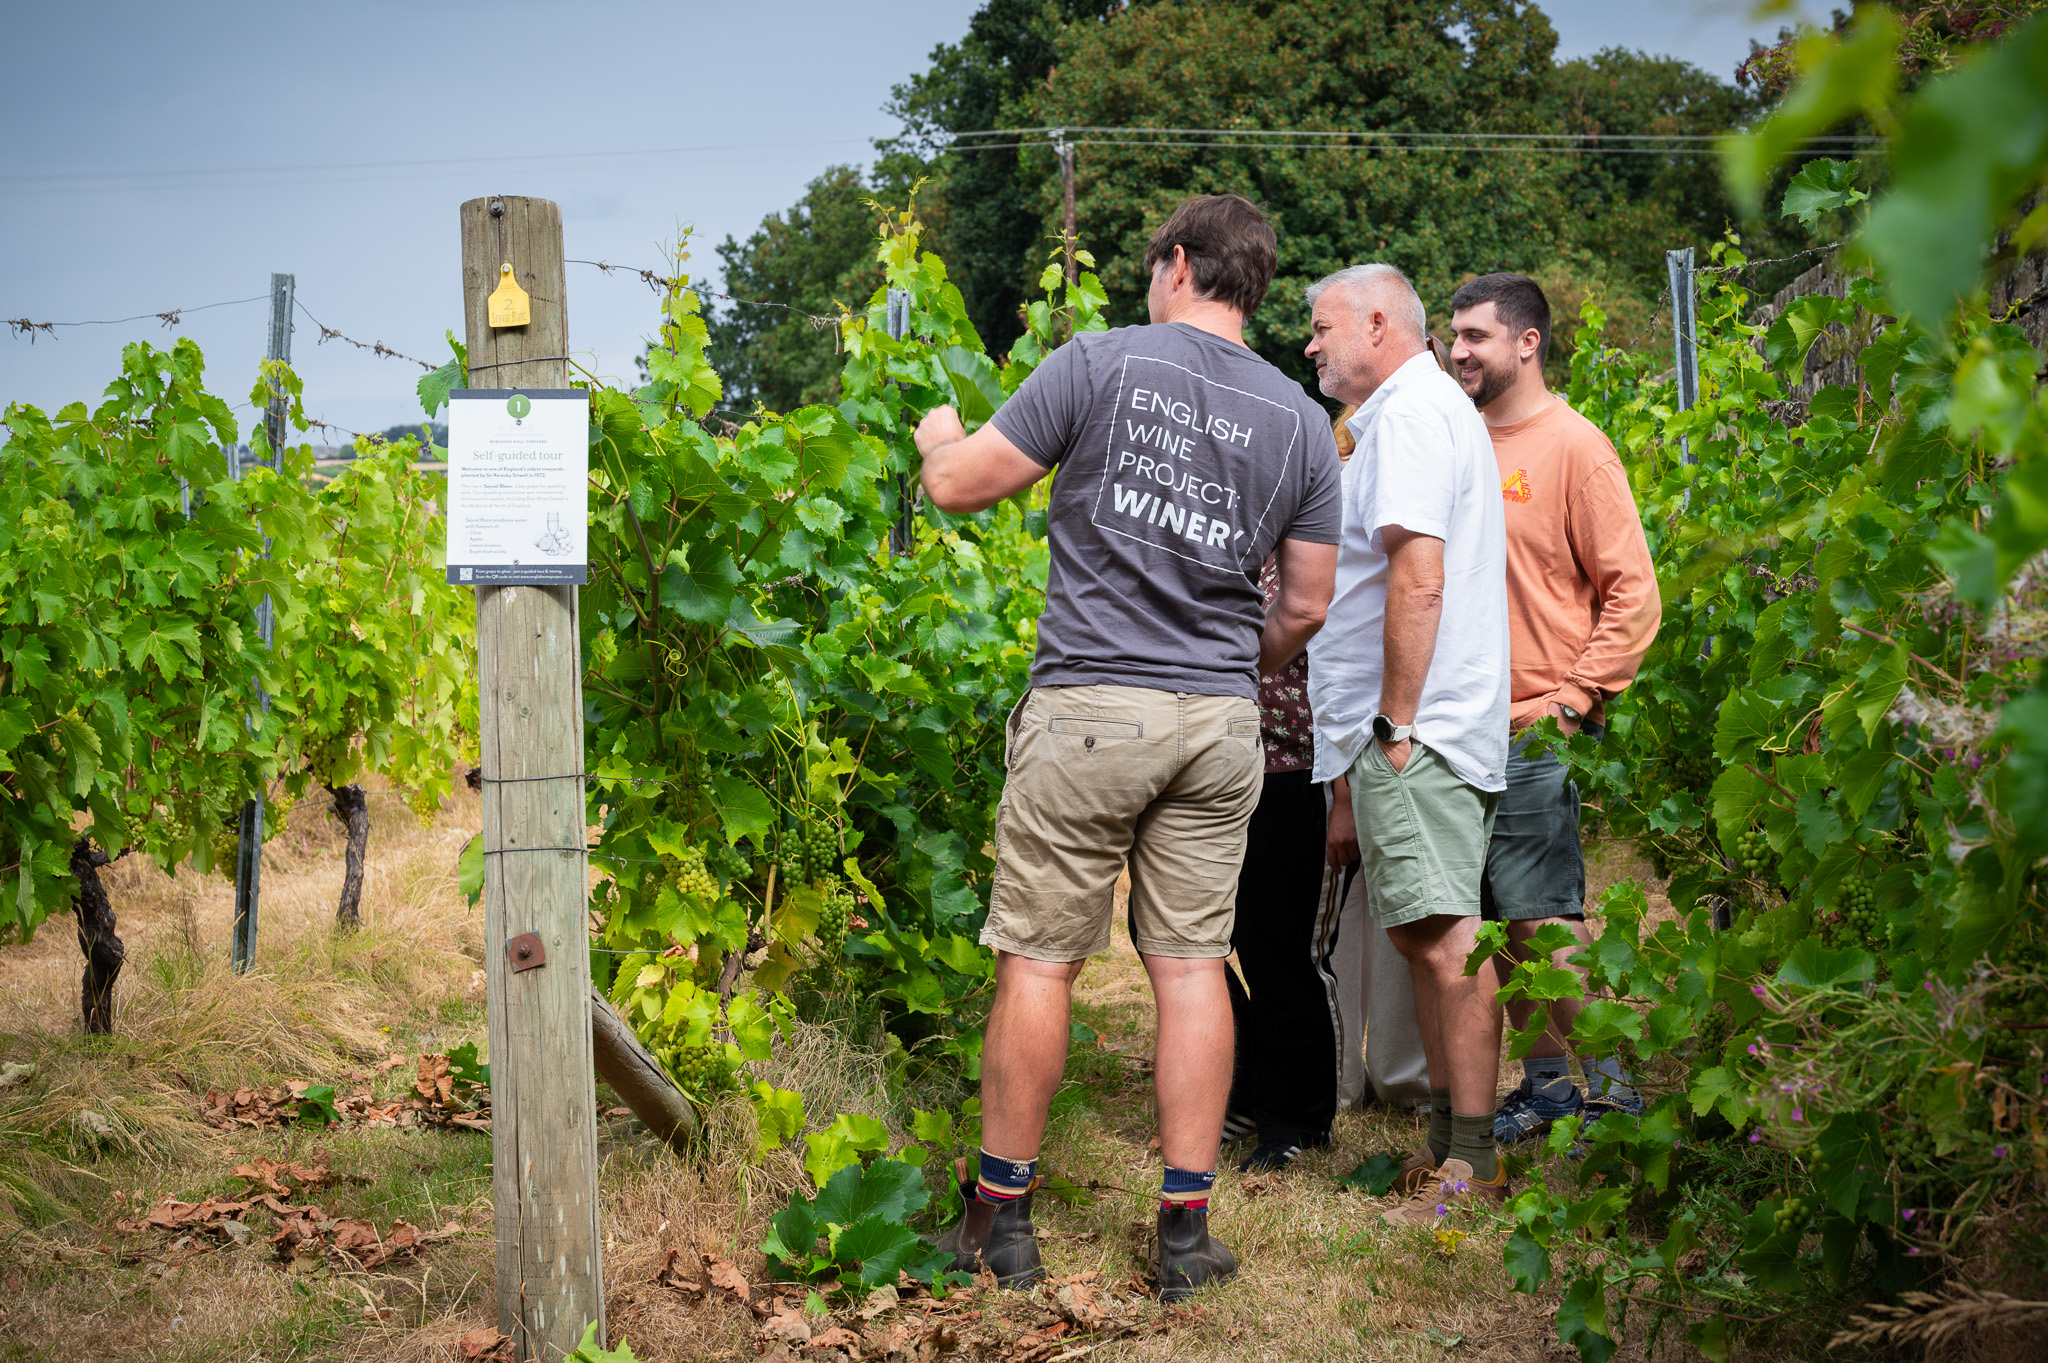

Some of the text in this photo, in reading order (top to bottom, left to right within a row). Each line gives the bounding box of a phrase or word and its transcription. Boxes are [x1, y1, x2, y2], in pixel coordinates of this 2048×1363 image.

[504, 299, 514, 310] 2
[516, 400, 521, 412] 1
[1132, 388, 1252, 448] ENGLISH
[1126, 419, 1196, 462] WINE
[473, 451, 564, 462] Self-guided tour
[1118, 451, 1240, 510] PROJECT:
